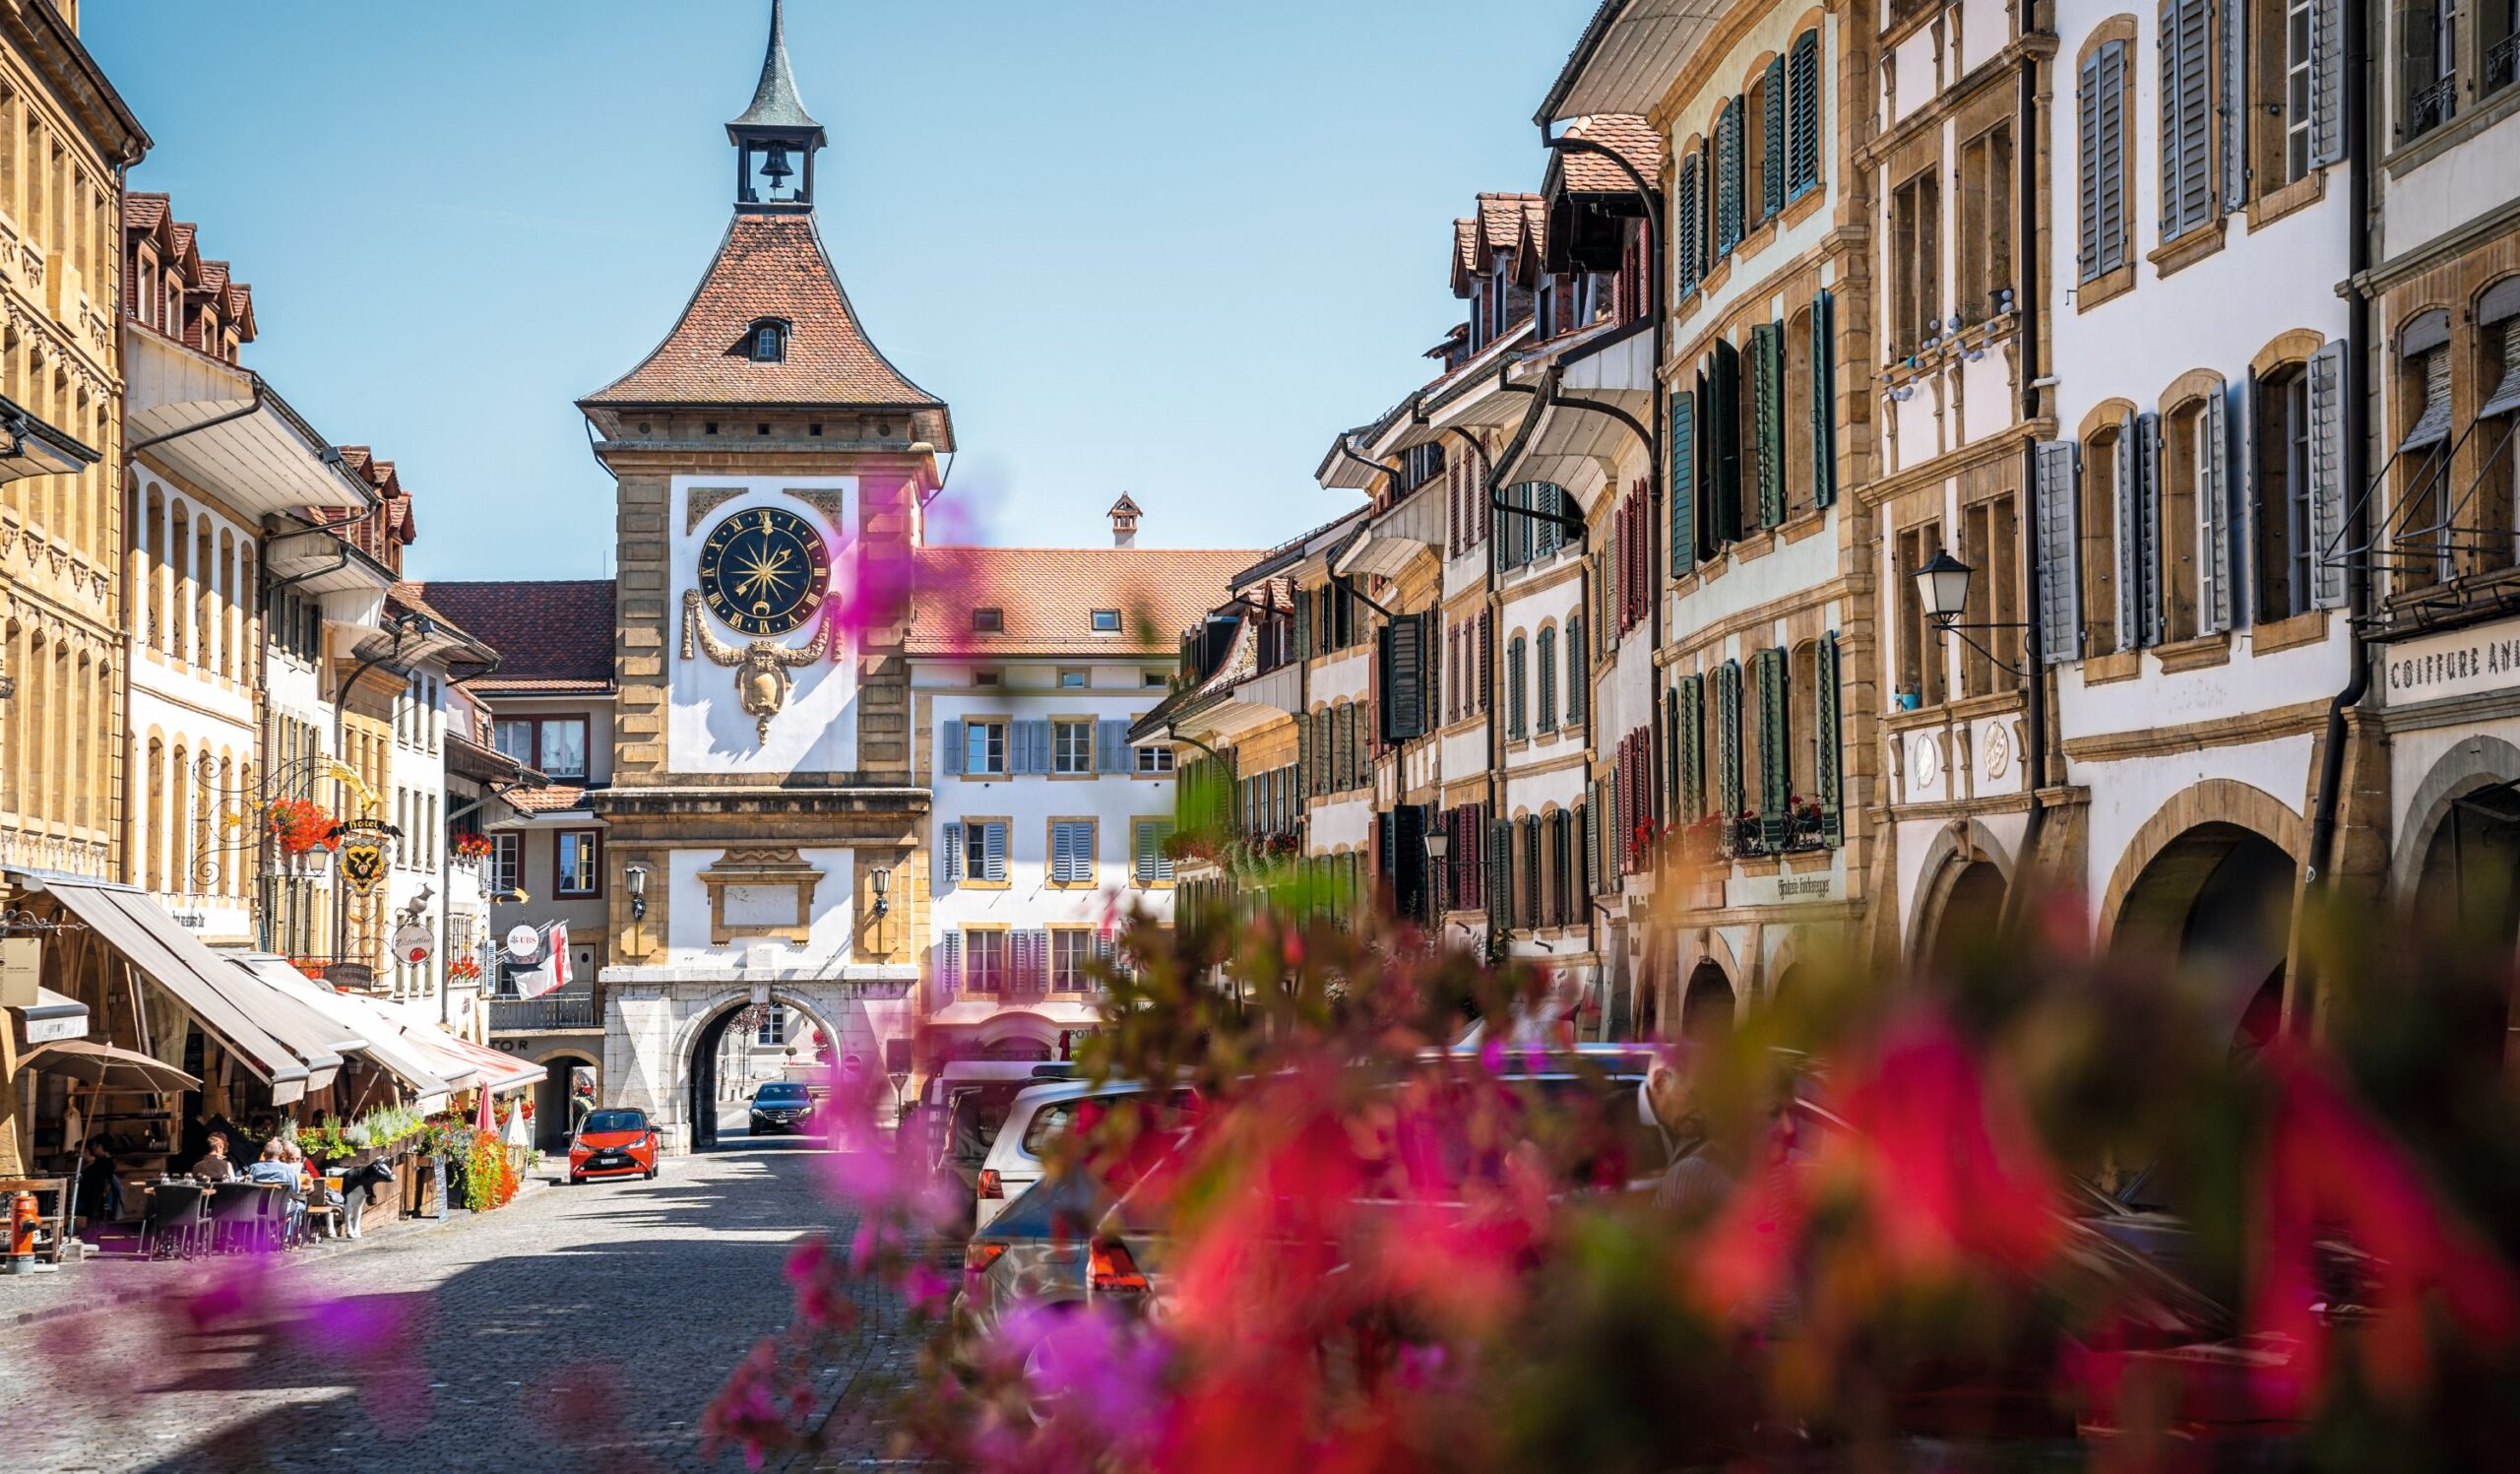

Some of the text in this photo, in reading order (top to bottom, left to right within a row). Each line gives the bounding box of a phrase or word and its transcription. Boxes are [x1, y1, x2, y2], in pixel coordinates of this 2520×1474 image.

[788, 519, 797, 531] I
[807, 540, 820, 551] II
[813, 567, 827, 577] III
[788, 613, 799, 627] V
[2390, 647, 2480, 689] COIFFURE
